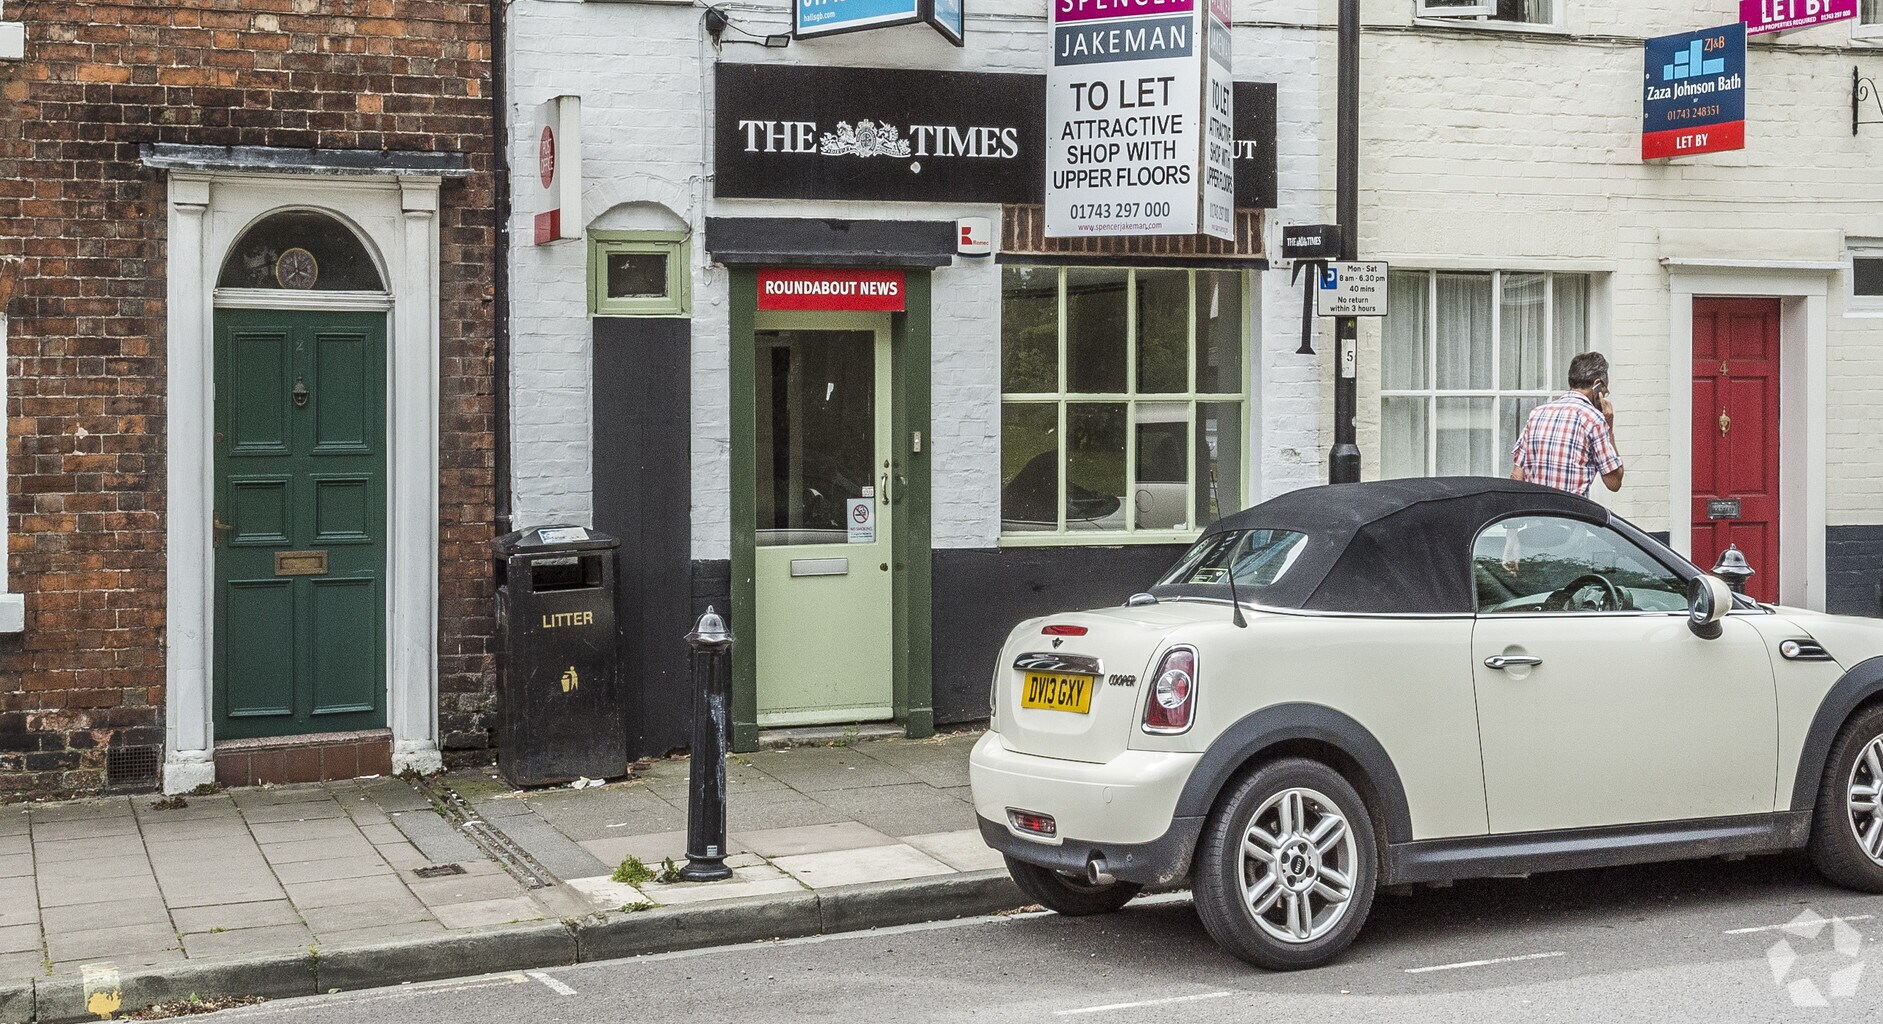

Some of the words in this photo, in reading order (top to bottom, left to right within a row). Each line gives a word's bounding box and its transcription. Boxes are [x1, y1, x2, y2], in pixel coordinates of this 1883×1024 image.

[803, 11, 836, 23] hallsgb.com
[1765, 20, 1792, 31] PROPERTIES
[1792, 16, 1817, 26] REQUIRED
[1062, 24, 1186, 57] JAKEMAN
[1704, 36, 1725, 52] ZJ&B
[1070, 81, 1109, 112] TO
[1119, 76, 1175, 109] LET
[1647, 86, 1671, 101] Zaza
[1673, 80, 1714, 100] Johnson
[1718, 73, 1741, 91] Bath
[1212, 78, 1219, 110] TO
[1220, 85, 1229, 117] LET
[1667, 108, 1690, 121] 01743
[1692, 105, 1720, 118] 248351
[1061, 114, 1183, 141] ATTRACTIVE
[738, 119, 817, 154] THE
[909, 124, 1019, 159] TIMES
[1676, 135, 1693, 150] LET
[1695, 133, 1709, 147] BY
[1067, 143, 1120, 165] SHOP
[1126, 140, 1176, 162] WITH
[1053, 167, 1112, 190] UPPER
[1116, 164, 1190, 187] FLOORS
[1070, 203, 1111, 220] 01743
[1115, 202, 1140, 218] 297
[1144, 201, 1170, 217] 000
[1078, 221, 1162, 232] www.spencerjakeman.com
[1287, 236, 1297, 247] THE
[1307, 236, 1321, 246] TIMES
[765, 279, 857, 296] ROUNDABOUT
[860, 280, 898, 297] NEWS
[1347, 350, 1354, 362] 5
[1720, 360, 1729, 376] 4
[542, 611, 593, 629] LITTER
[1108, 674, 1136, 687] COOPER
[1029, 677, 1056, 704] DV13
[1058, 679, 1085, 707] GXY
